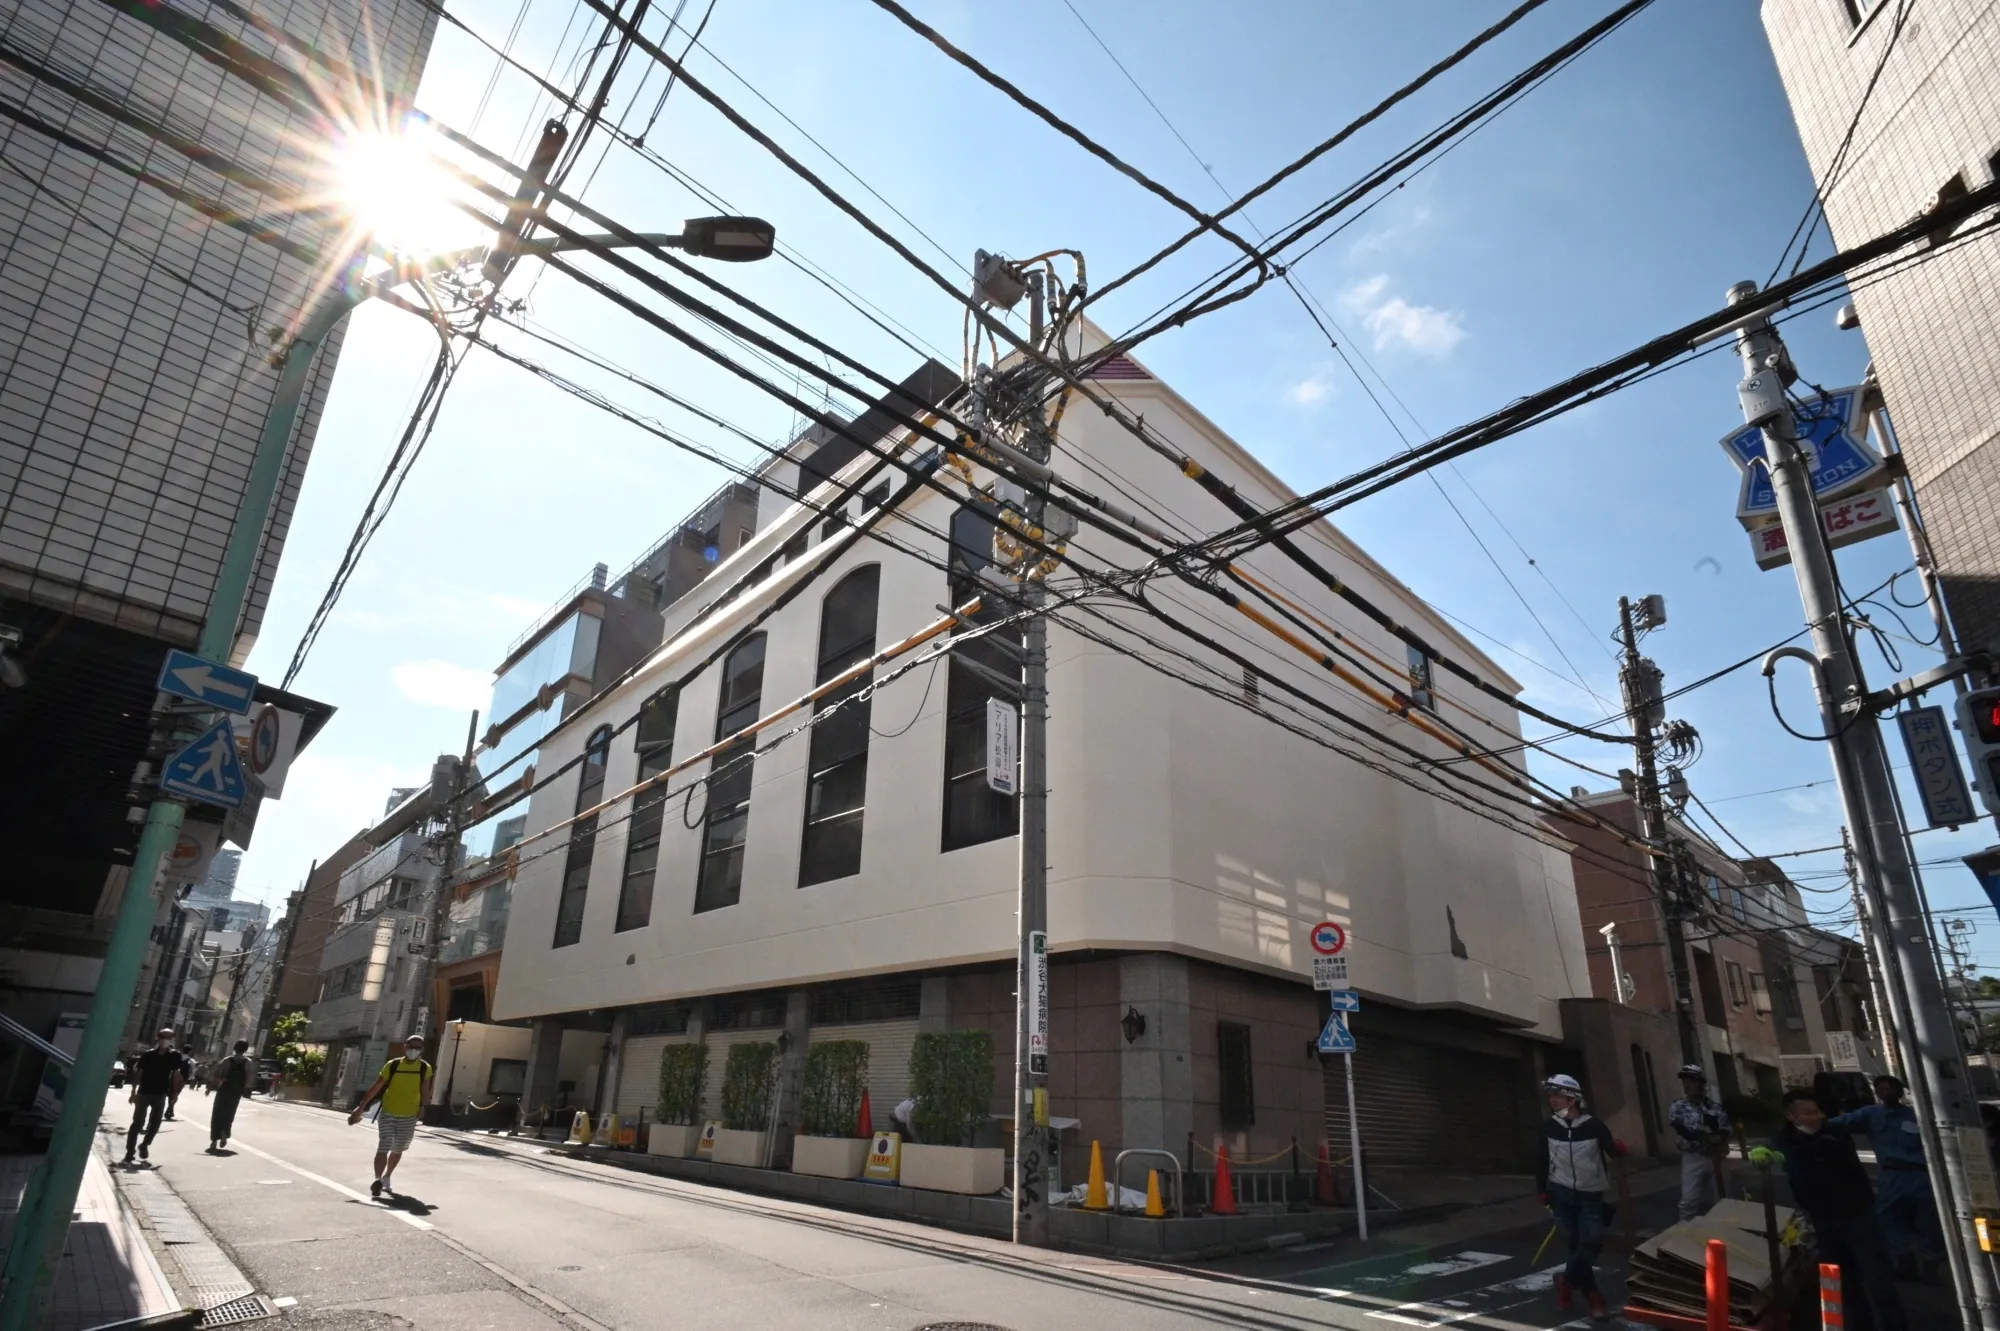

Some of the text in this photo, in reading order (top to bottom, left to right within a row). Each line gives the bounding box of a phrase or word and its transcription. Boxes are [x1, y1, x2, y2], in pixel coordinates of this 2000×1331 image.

[1758, 458, 1858, 502] SION
[1910, 717, 1962, 816] 押ボタン式
